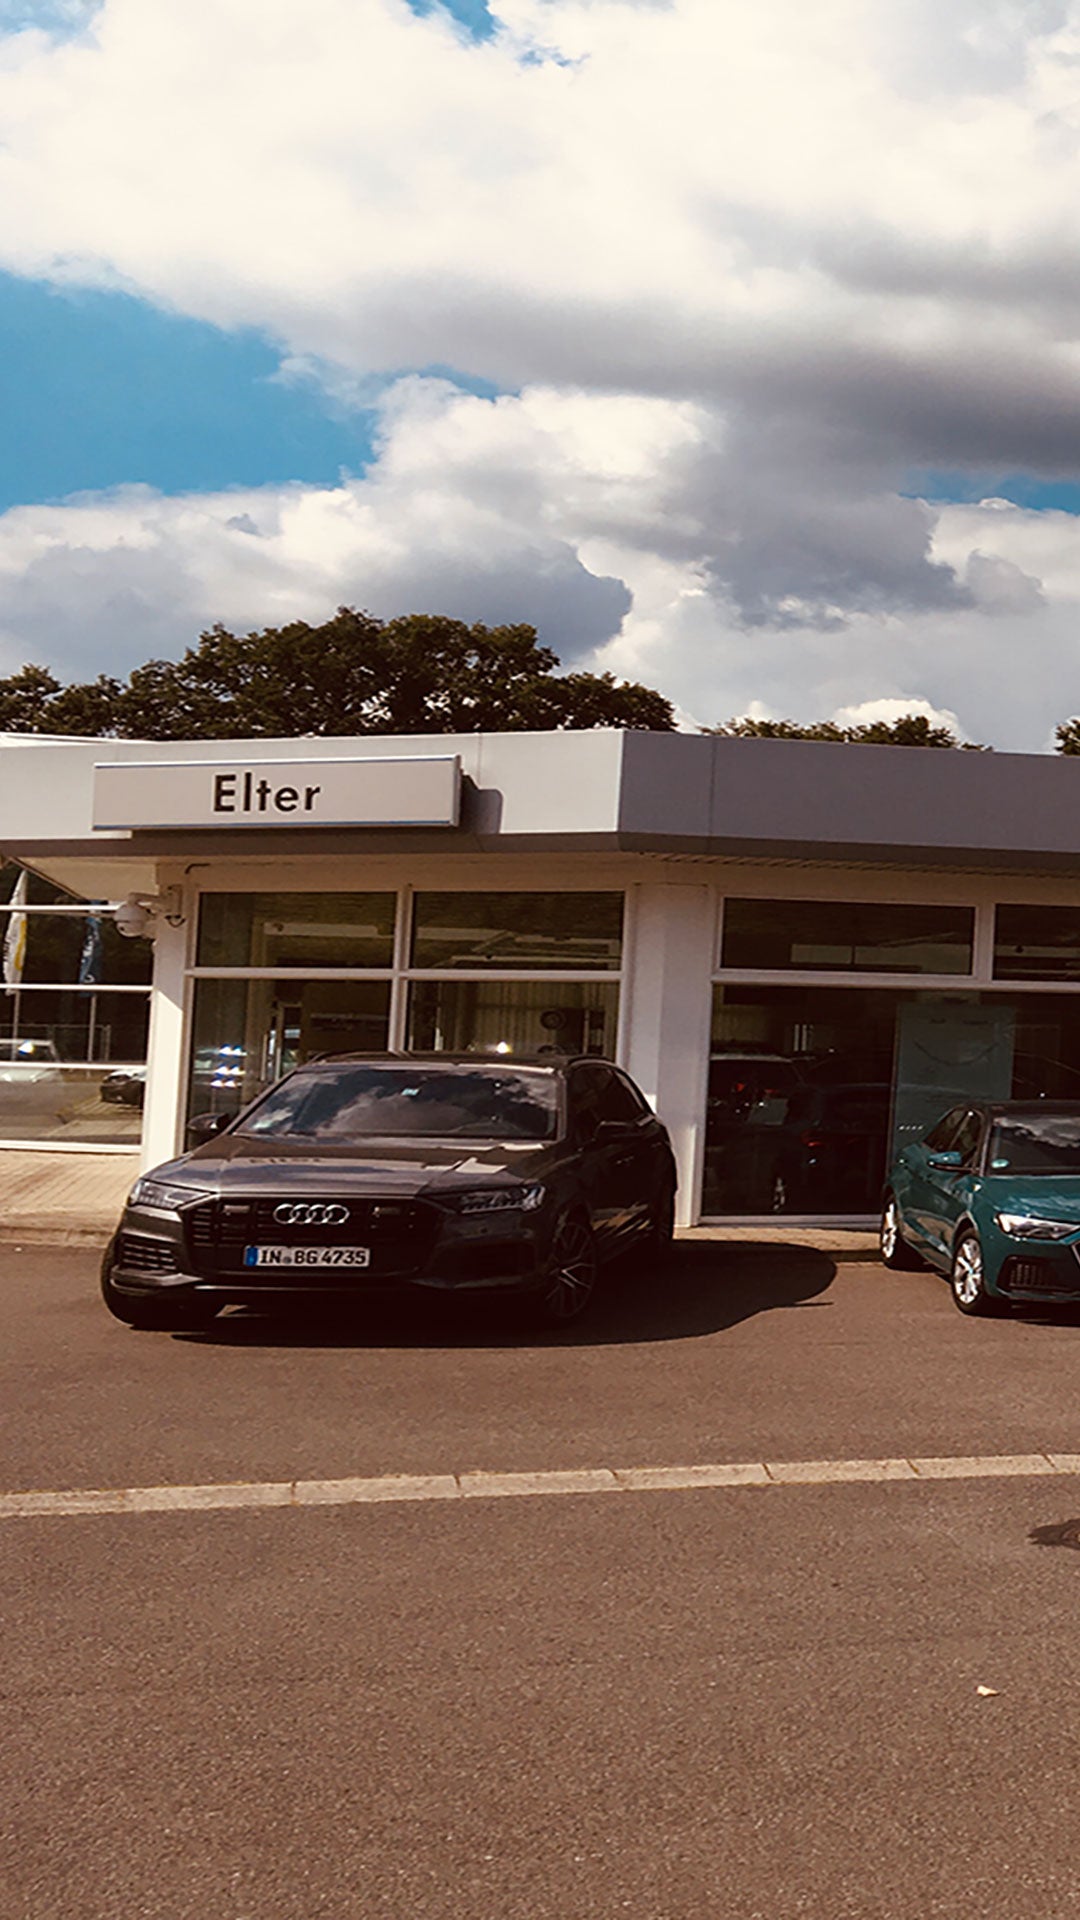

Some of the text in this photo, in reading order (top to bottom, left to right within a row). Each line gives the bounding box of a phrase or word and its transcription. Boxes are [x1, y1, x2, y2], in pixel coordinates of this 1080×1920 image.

[213, 771, 321, 812] Elter
[260, 1250, 282, 1265] IN
[294, 1250, 318, 1265] BG
